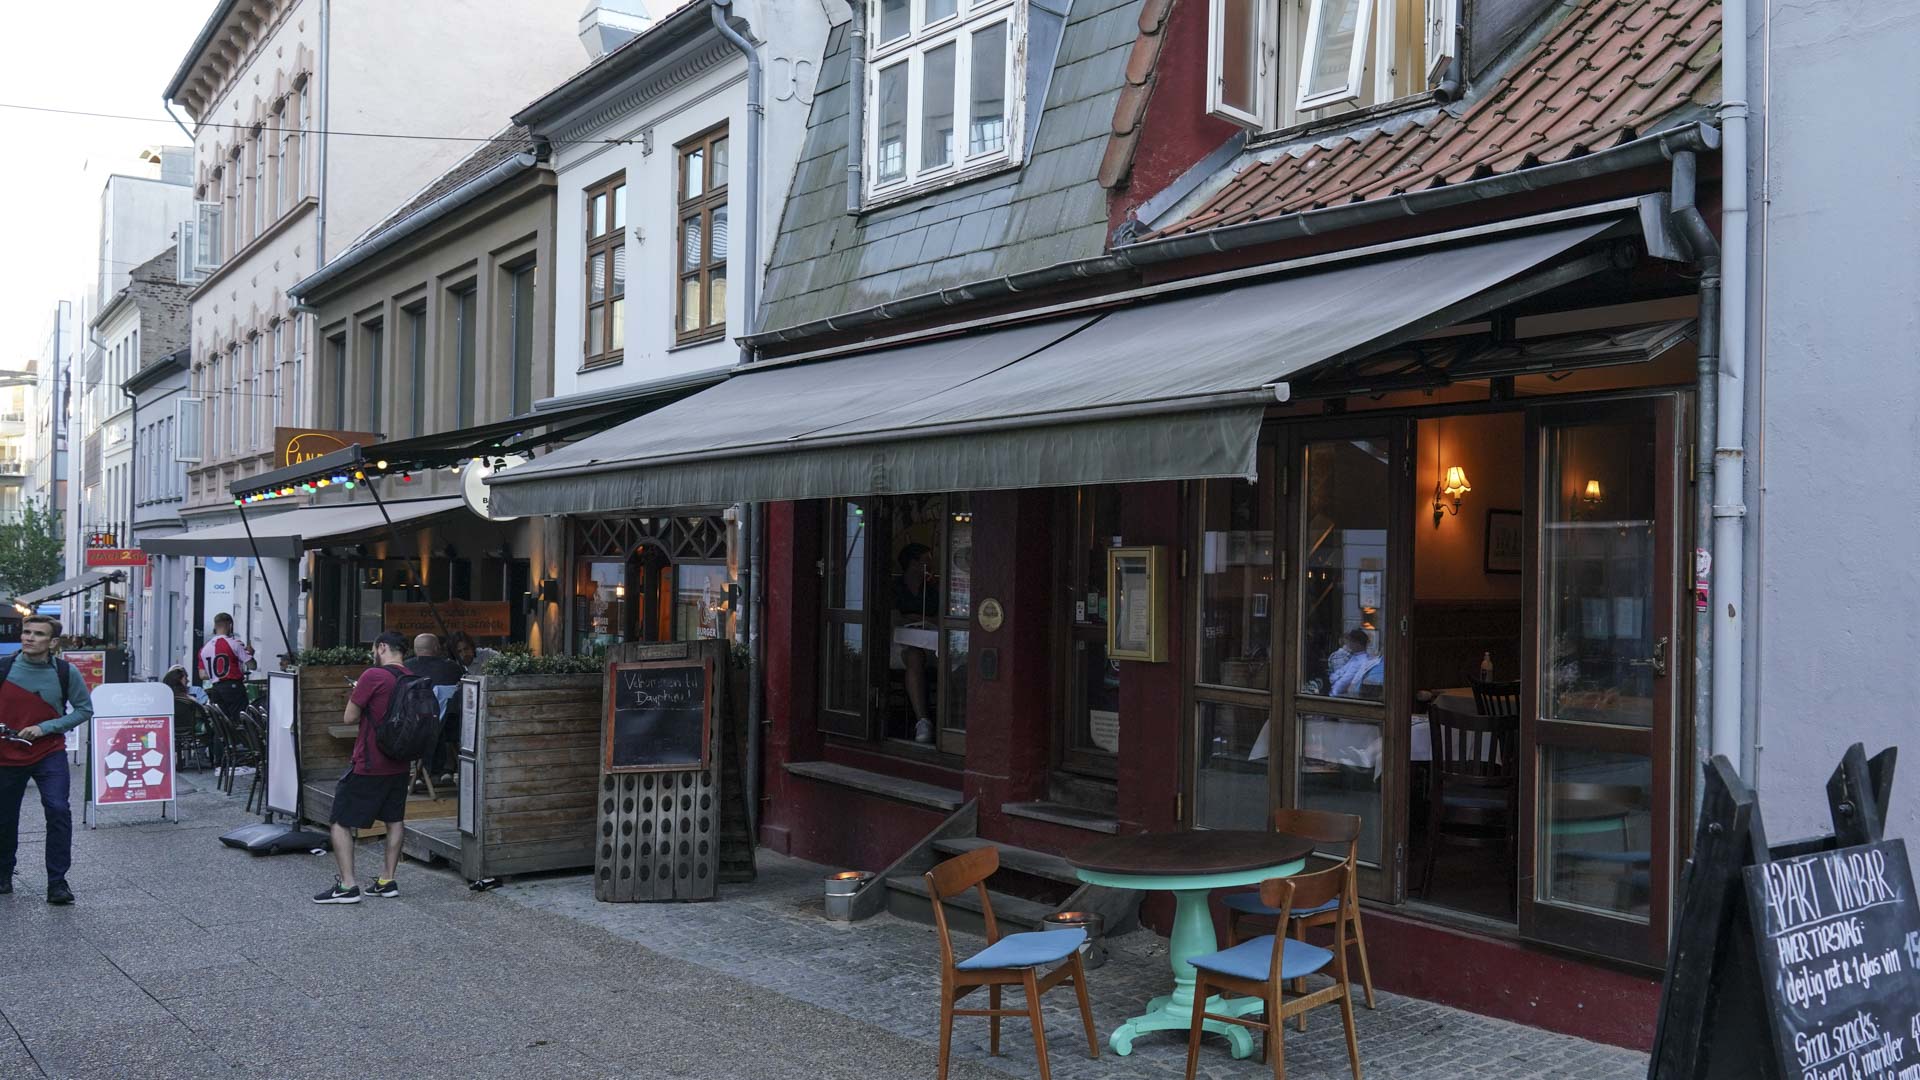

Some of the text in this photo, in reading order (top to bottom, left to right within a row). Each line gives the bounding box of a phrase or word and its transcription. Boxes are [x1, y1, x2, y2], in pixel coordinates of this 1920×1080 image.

[206, 654, 231, 679] 10
[1762, 849, 1895, 931] APART VINBAR
[1777, 917, 1865, 968] HVER TIRSDAG:
[1786, 965, 1827, 1009] dejlig
[1824, 958, 1843, 991] ret
[1842, 960, 1853, 984] &
[1852, 956, 1861, 983] 1
[1860, 952, 1881, 989] glas
[1880, 947, 1901, 975] vin
[1861, 1031, 1904, 1077] mandler
